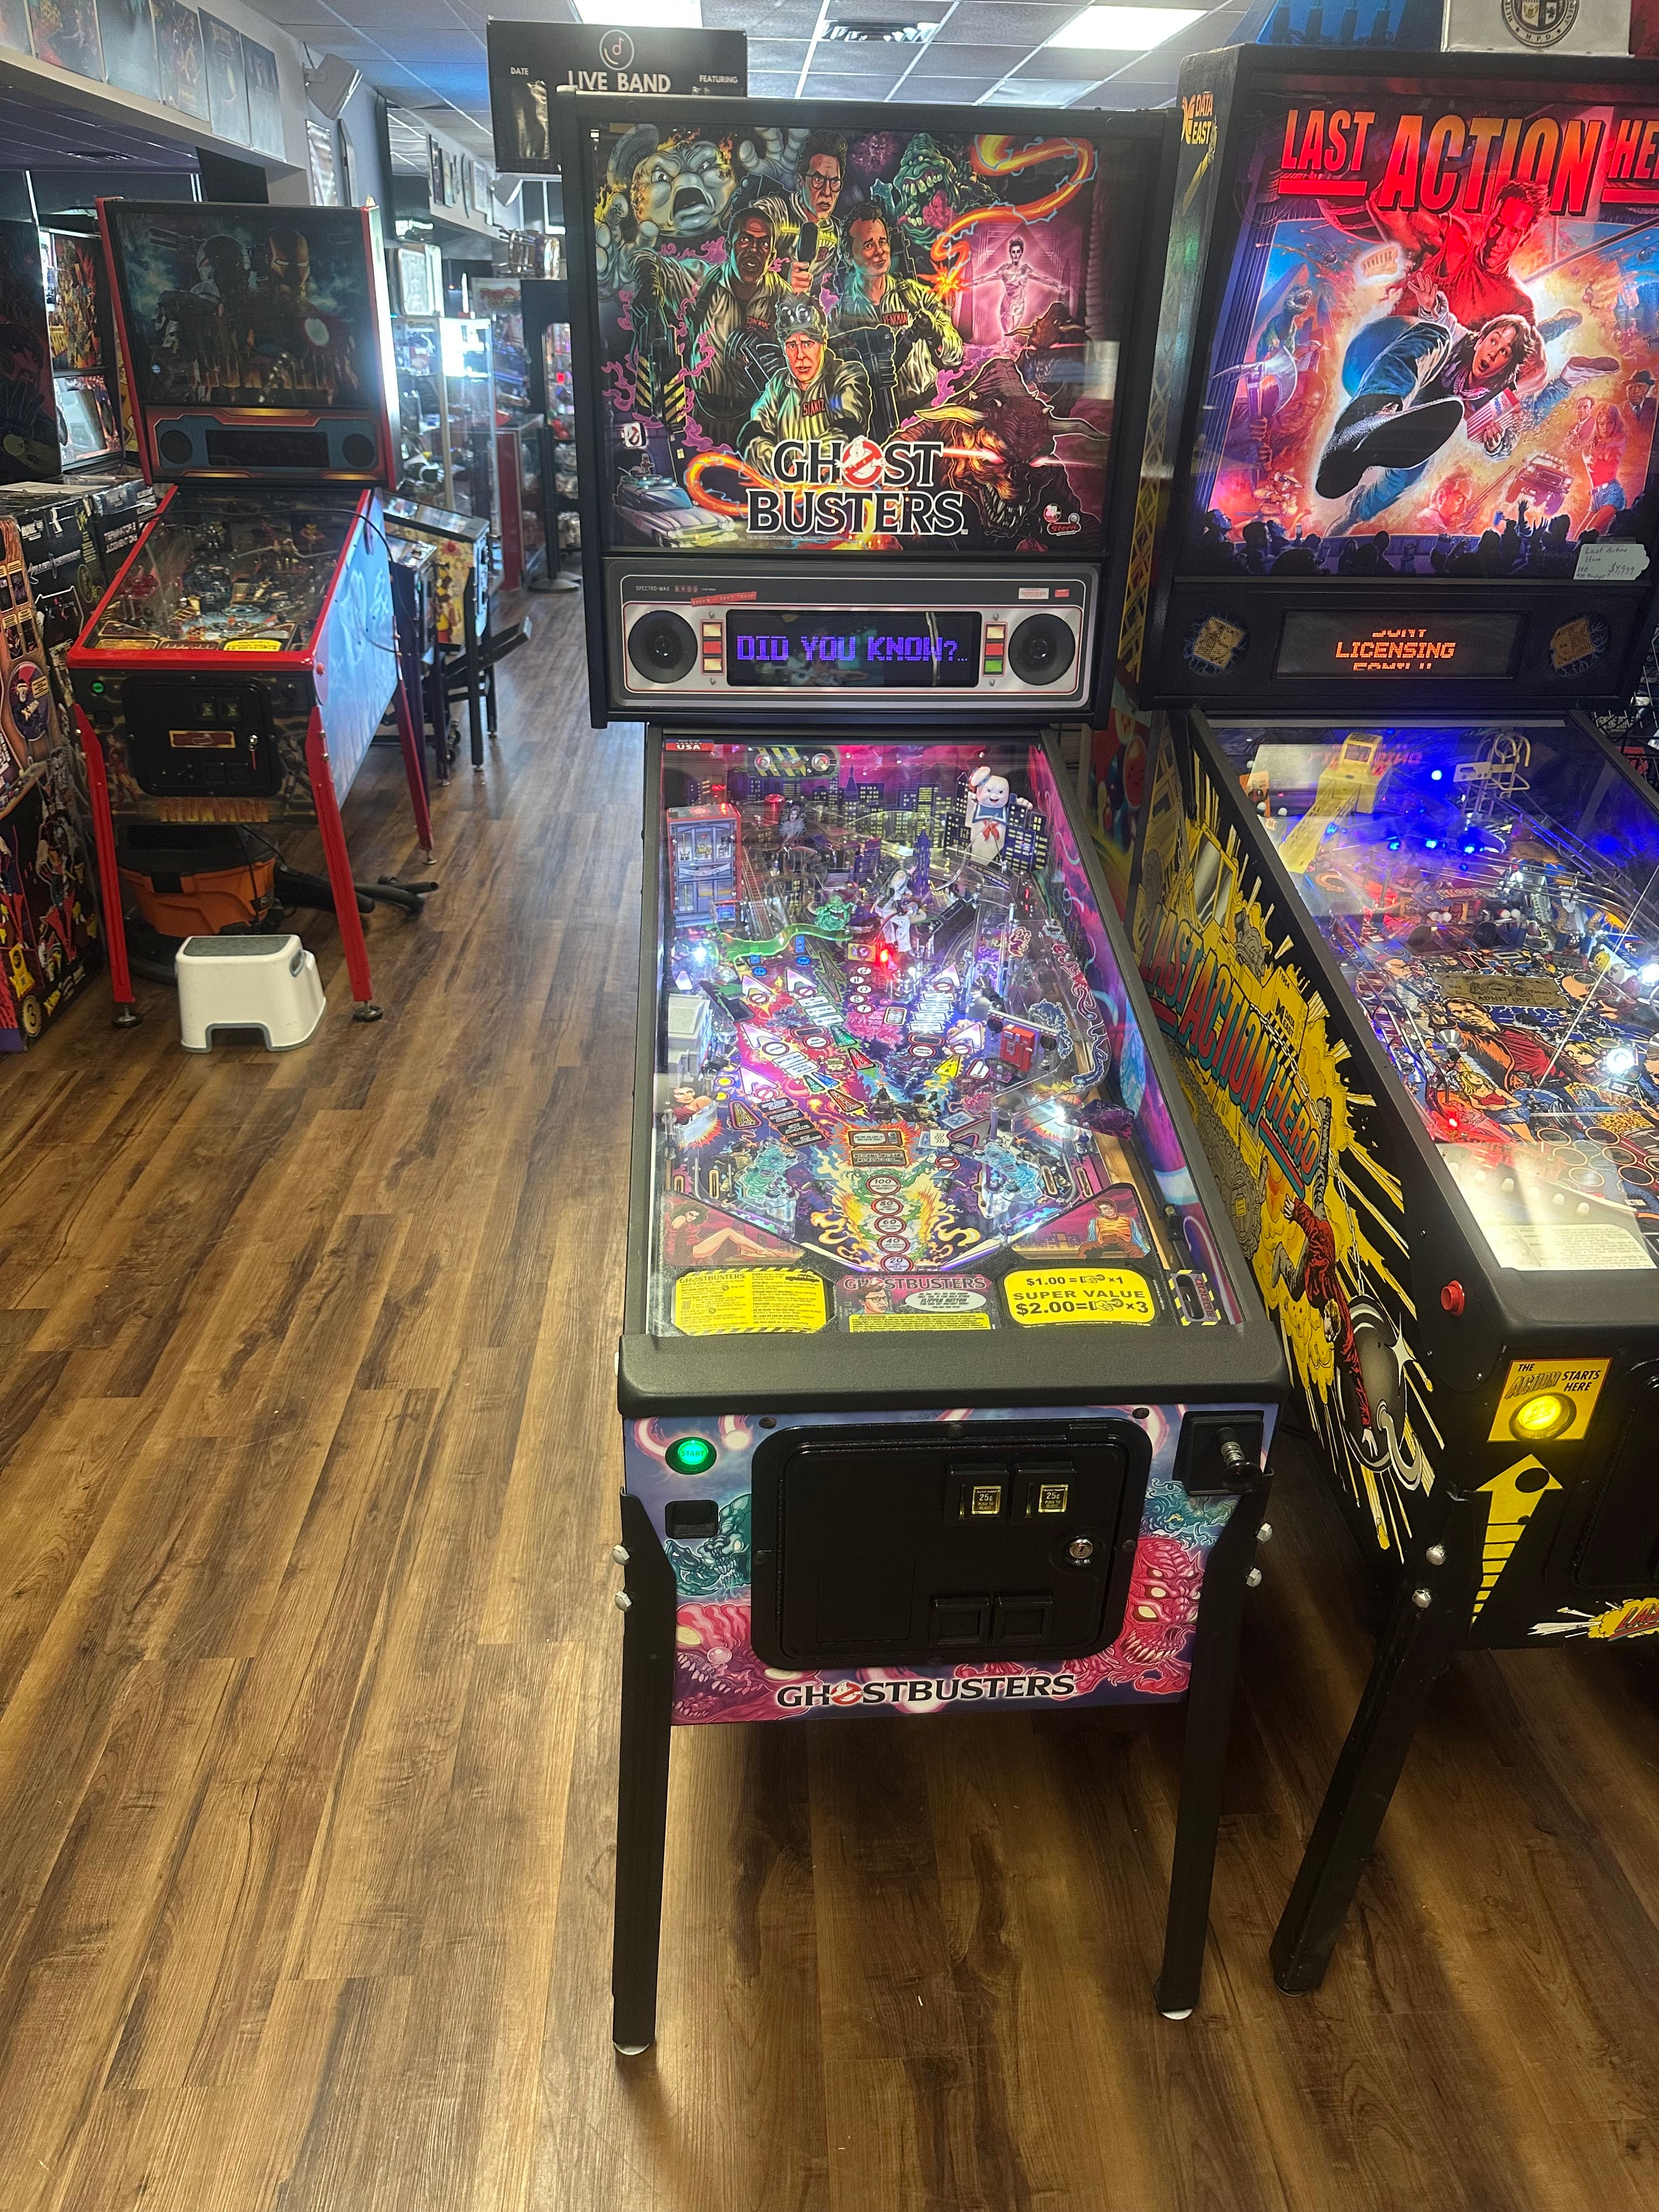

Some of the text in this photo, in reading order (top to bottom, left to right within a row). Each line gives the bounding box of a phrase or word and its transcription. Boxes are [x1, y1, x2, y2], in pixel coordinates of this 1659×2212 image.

[568, 71, 671, 93] LIVE BAND
[699, 75, 738, 84] FEATURING
[1195, 92, 1213, 117] DATA
[1192, 120, 1211, 144] EAST
[1280, 109, 1375, 172] LAST
[1378, 114, 1606, 215] ACTION
[883, 312, 909, 326] VENKMAN
[747, 491, 964, 535] BUSTERS
[737, 635, 789, 661] DID
[802, 635, 856, 661] YOU
[1335, 641, 1456, 659] LICENSING
[1284, 1009, 1295, 1029] DATA
[1283, 1020, 1294, 1039] EAST
[1140, 901, 1320, 1186] LAST ACTION HERO
[680, 1273, 745, 1284] GHOSTBUSTERS
[844, 1277, 988, 1290] GHOSTBUSTERS
[1026, 1276, 1065, 1286] $1.00
[1013, 1289, 1146, 1301] SUPER VALUE
[1517, 1363, 1536, 1372] THE
[1504, 1370, 1601, 1400] ACTION STARTS
[1564, 1382, 1593, 1392] HERE
[979, 1493, 993, 1502] 25¢
[1046, 1492, 1060, 1500] 25¢
[778, 1674, 1076, 1707] GHOSTBUSTERS
